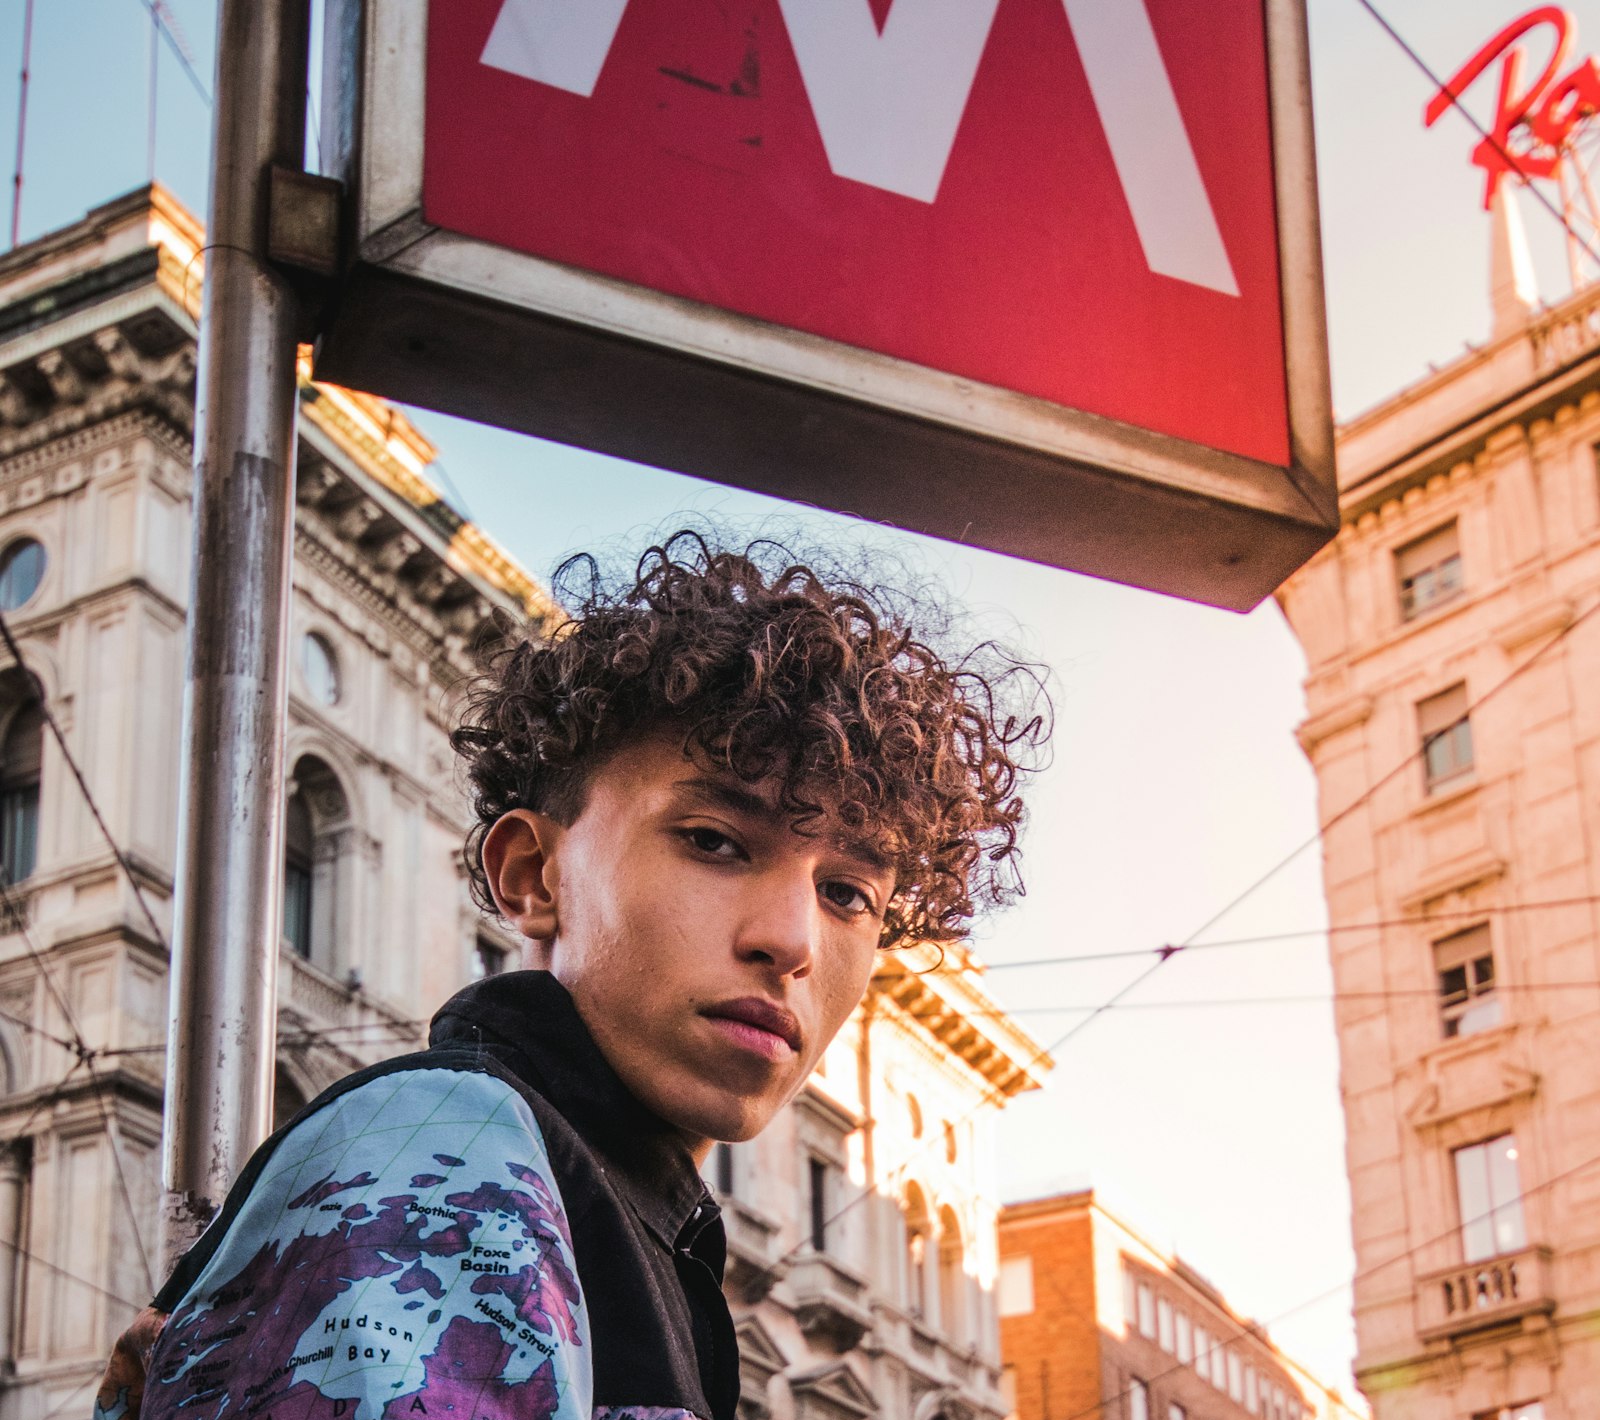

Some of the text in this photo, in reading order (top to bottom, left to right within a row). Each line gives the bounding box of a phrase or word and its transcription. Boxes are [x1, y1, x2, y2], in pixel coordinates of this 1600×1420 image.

[409, 1202, 457, 1220] Boothia
[473, 1246, 511, 1260] Foxe
[460, 1258, 510, 1275] Basin
[324, 1314, 413, 1342] Hudson
[474, 1298, 556, 1359] Hudson Strait
[288, 1346, 333, 1368] Churchill
[348, 1345, 390, 1363] Bay
